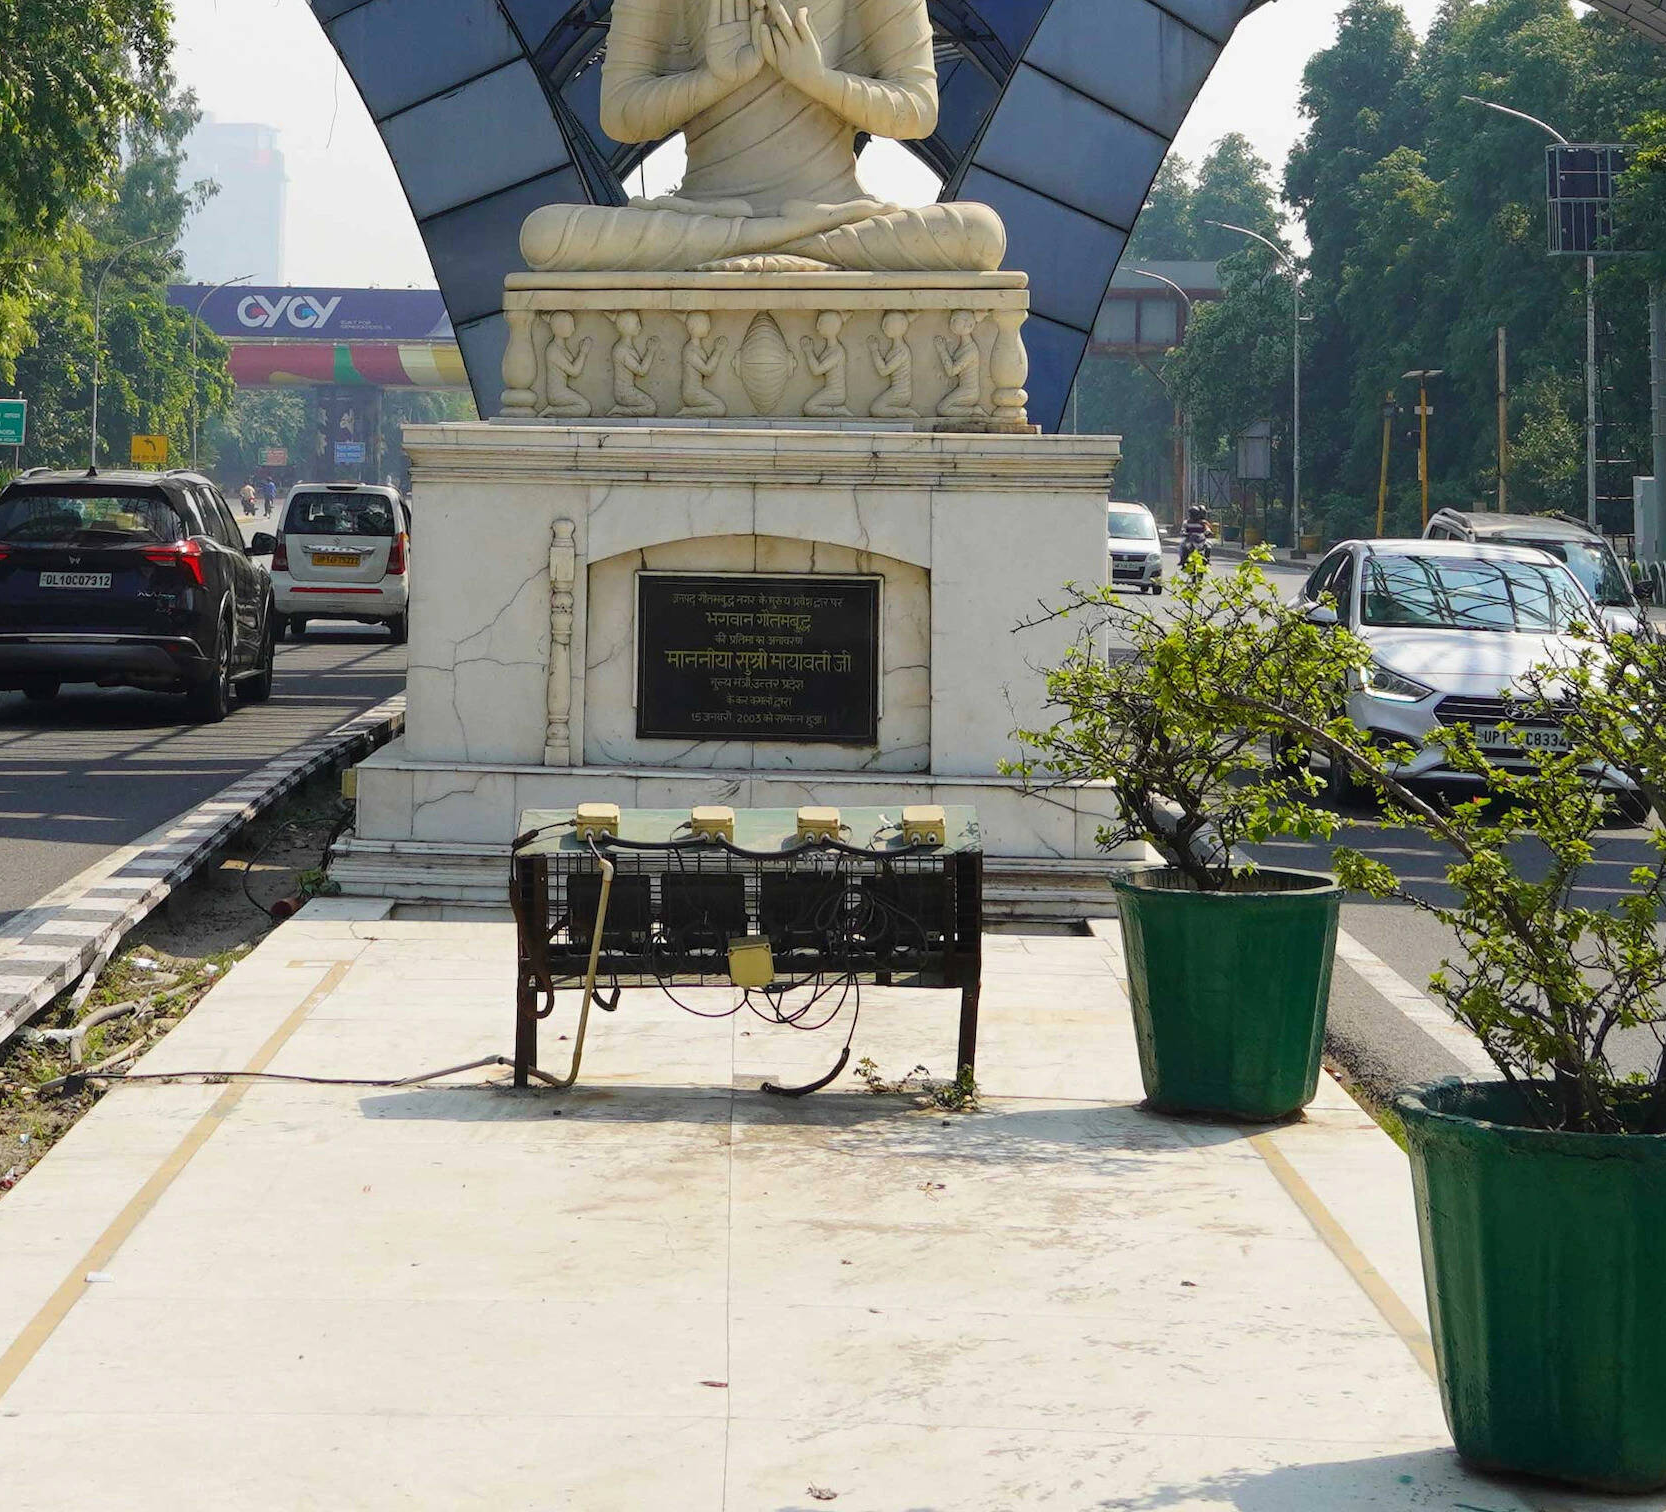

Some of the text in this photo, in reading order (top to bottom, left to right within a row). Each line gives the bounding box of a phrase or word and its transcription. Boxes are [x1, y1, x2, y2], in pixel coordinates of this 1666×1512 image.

[236, 294, 343, 329] CYCY
[705, 611, 755, 628] भगवान
[664, 647, 853, 676] माननीया सुश्री मायावती जी
[1483, 729, 1567, 748] UP1C8334
